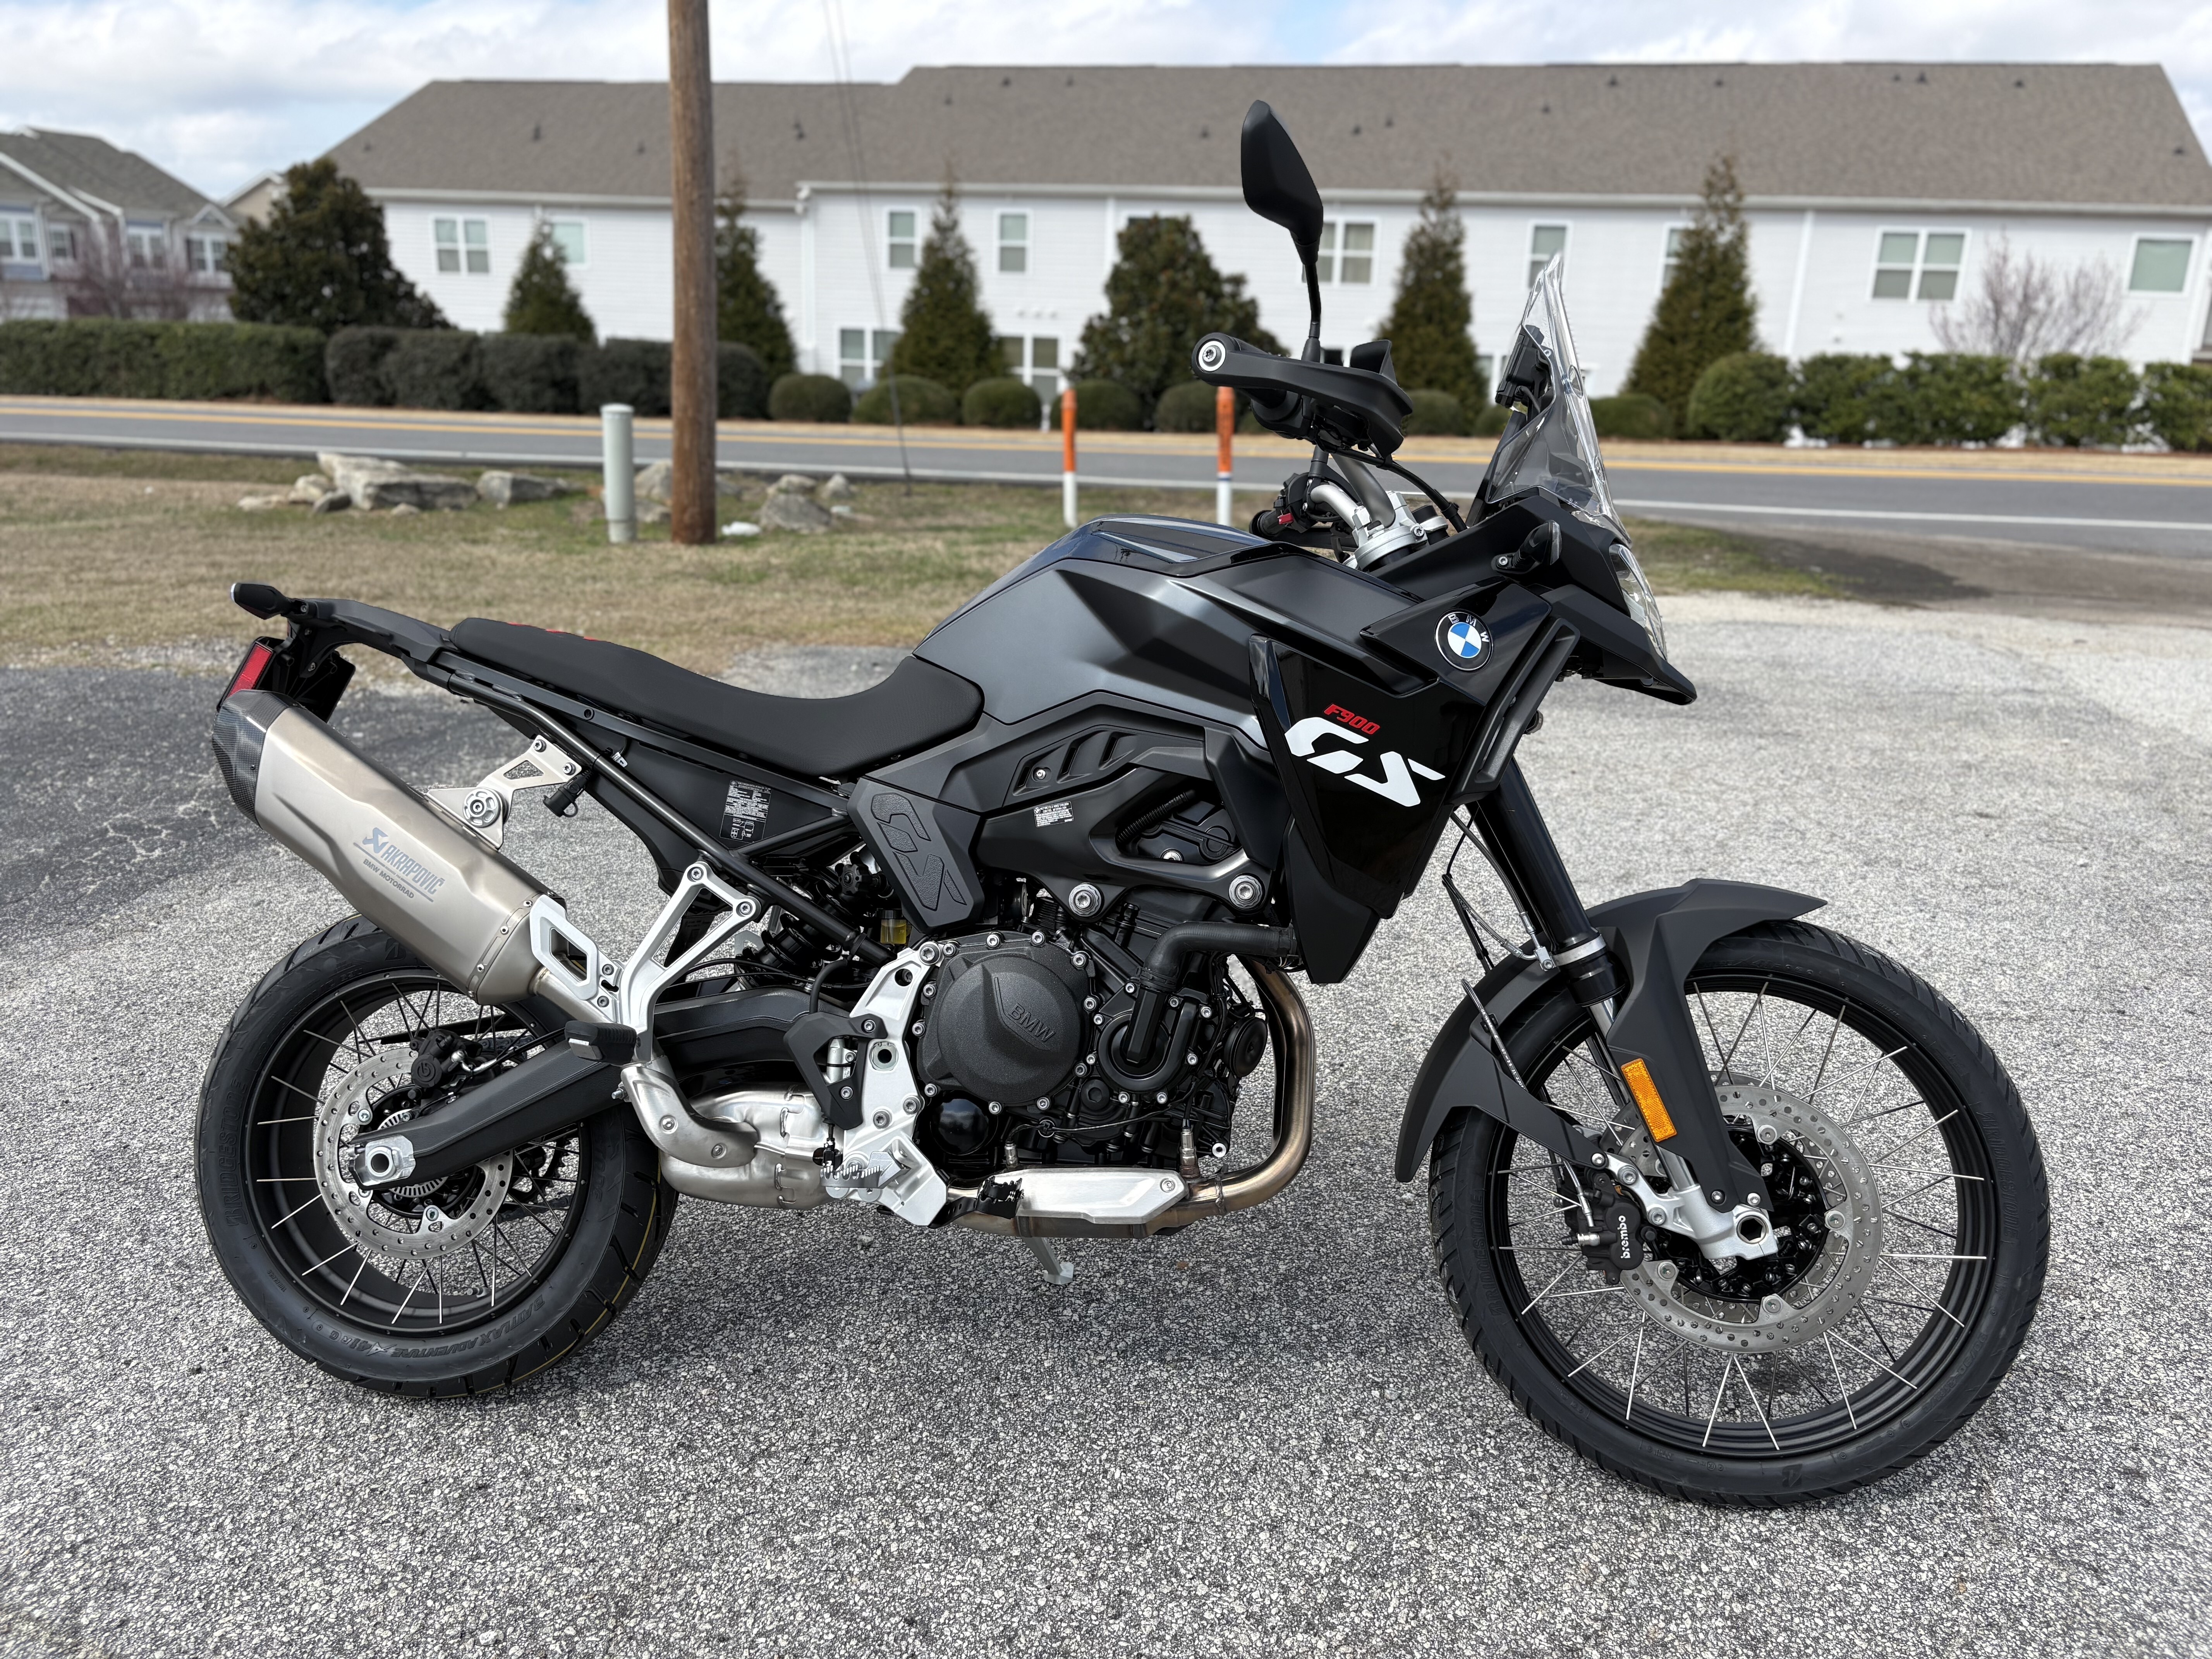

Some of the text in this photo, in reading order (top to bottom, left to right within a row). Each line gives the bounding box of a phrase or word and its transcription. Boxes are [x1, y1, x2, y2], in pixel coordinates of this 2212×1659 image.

[1448, 614, 1489, 643] BMW
[1324, 703, 1380, 735] F900
[1285, 717, 1446, 807] GS
[363, 859, 380, 873] BMW
[379, 871, 414, 898] MOTORRAD
[1007, 1003, 1056, 1043] BMW
[218, 1078, 248, 1227] BRIDGESTONE
[1977, 1111, 2018, 1237] BRIDGESTONE
[1472, 1195, 1503, 1317] BRIDGESTONE
[1618, 1215, 1631, 1259] brembo
[476, 1294, 546, 1344] BATTLAX
[390, 1338, 478, 1358] ADVENTURE
